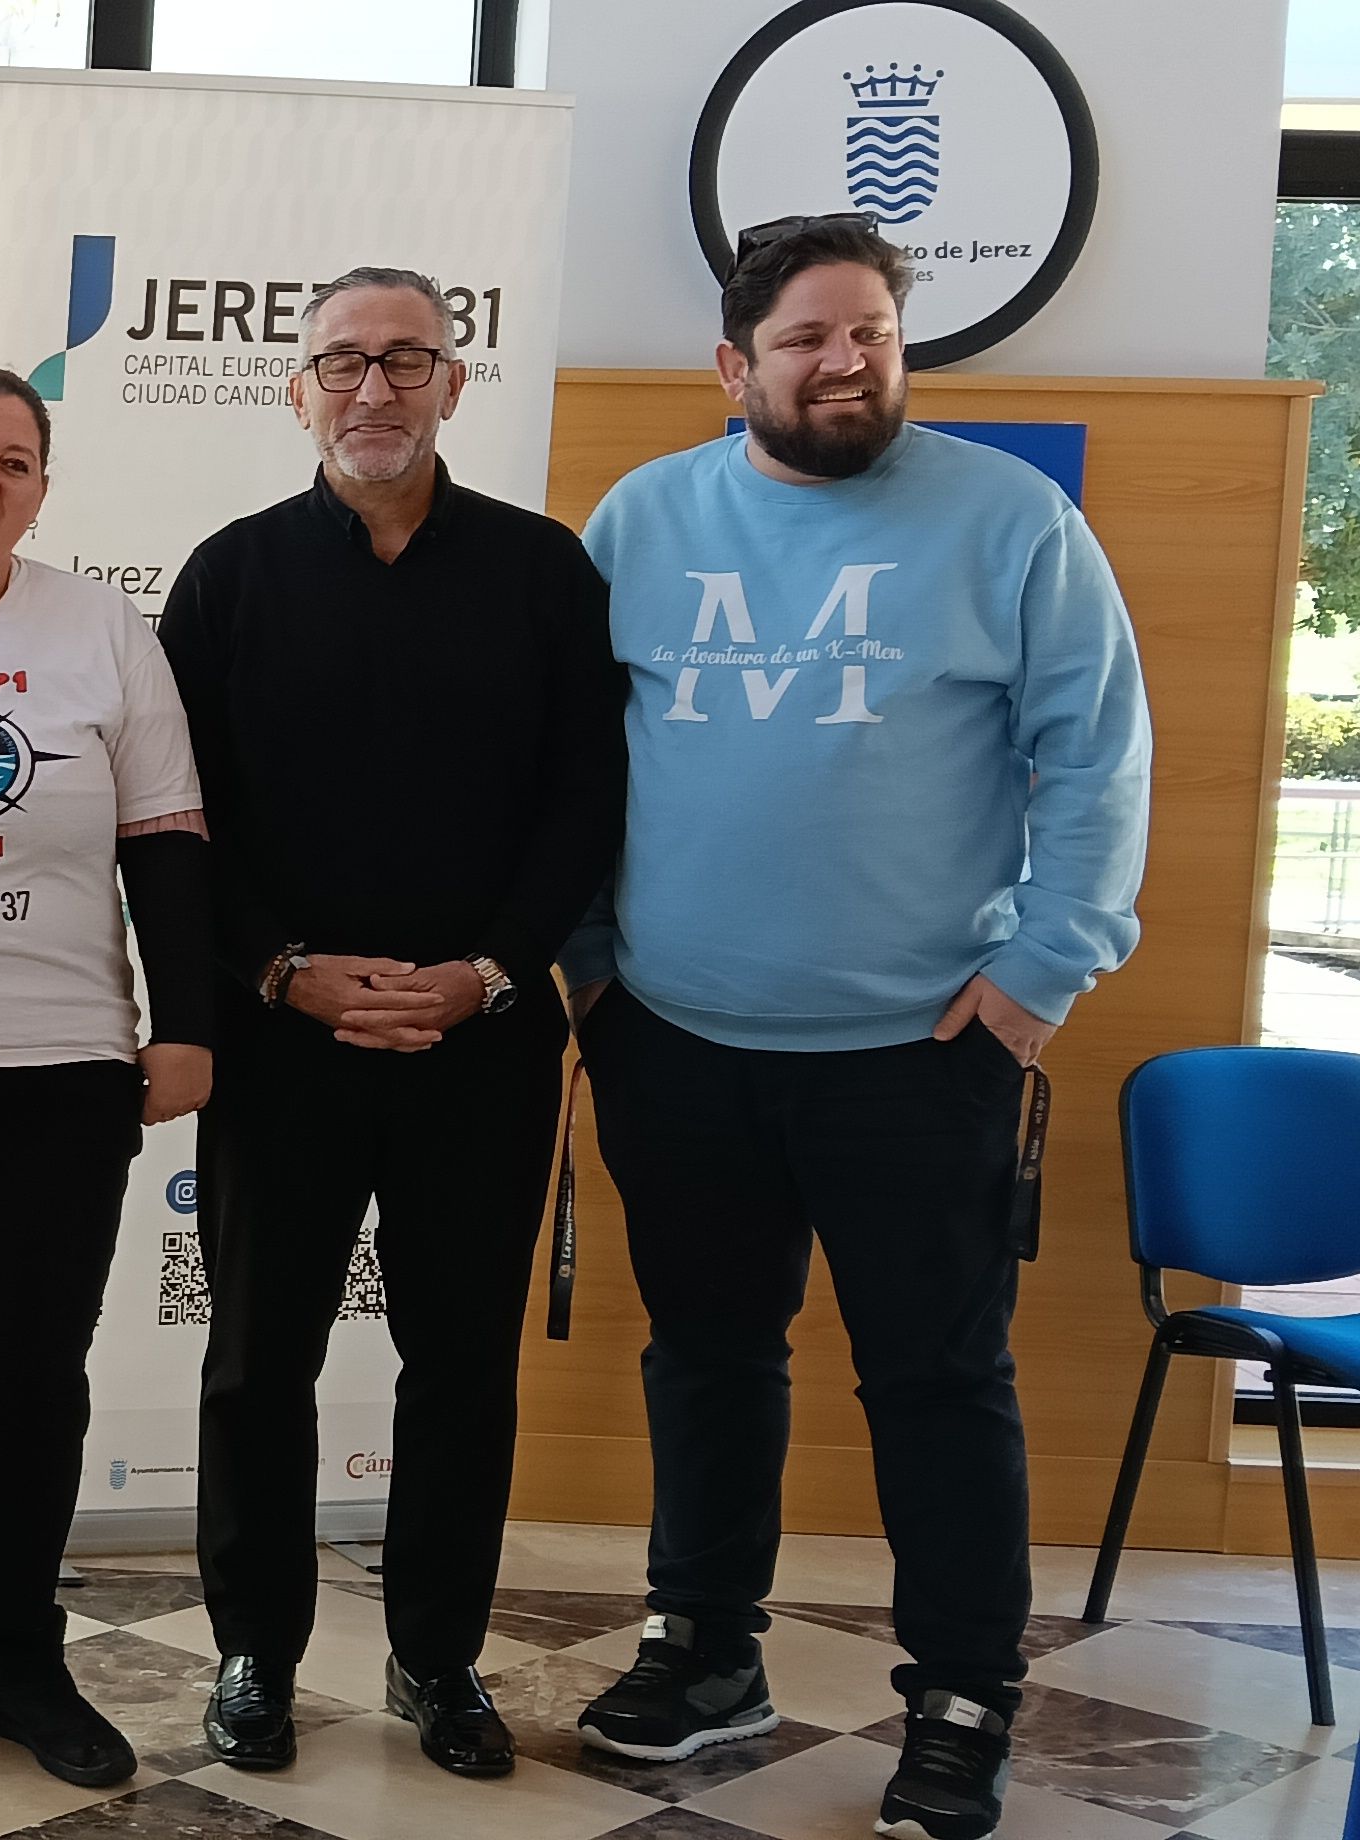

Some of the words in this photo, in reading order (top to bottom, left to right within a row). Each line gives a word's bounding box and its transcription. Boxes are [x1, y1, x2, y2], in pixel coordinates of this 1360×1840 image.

[935, 241, 963, 258] de
[970, 240, 1032, 262] Jerez
[125, 355, 213, 376] CAPITAL
[123, 383, 206, 404] CIUDAD
[681, 644, 767, 664] Aventura
[770, 644, 794, 664] de
[796, 648, 820, 661] un
[826, 638, 904, 660] X-Men
[2, 891, 30, 920] 37
